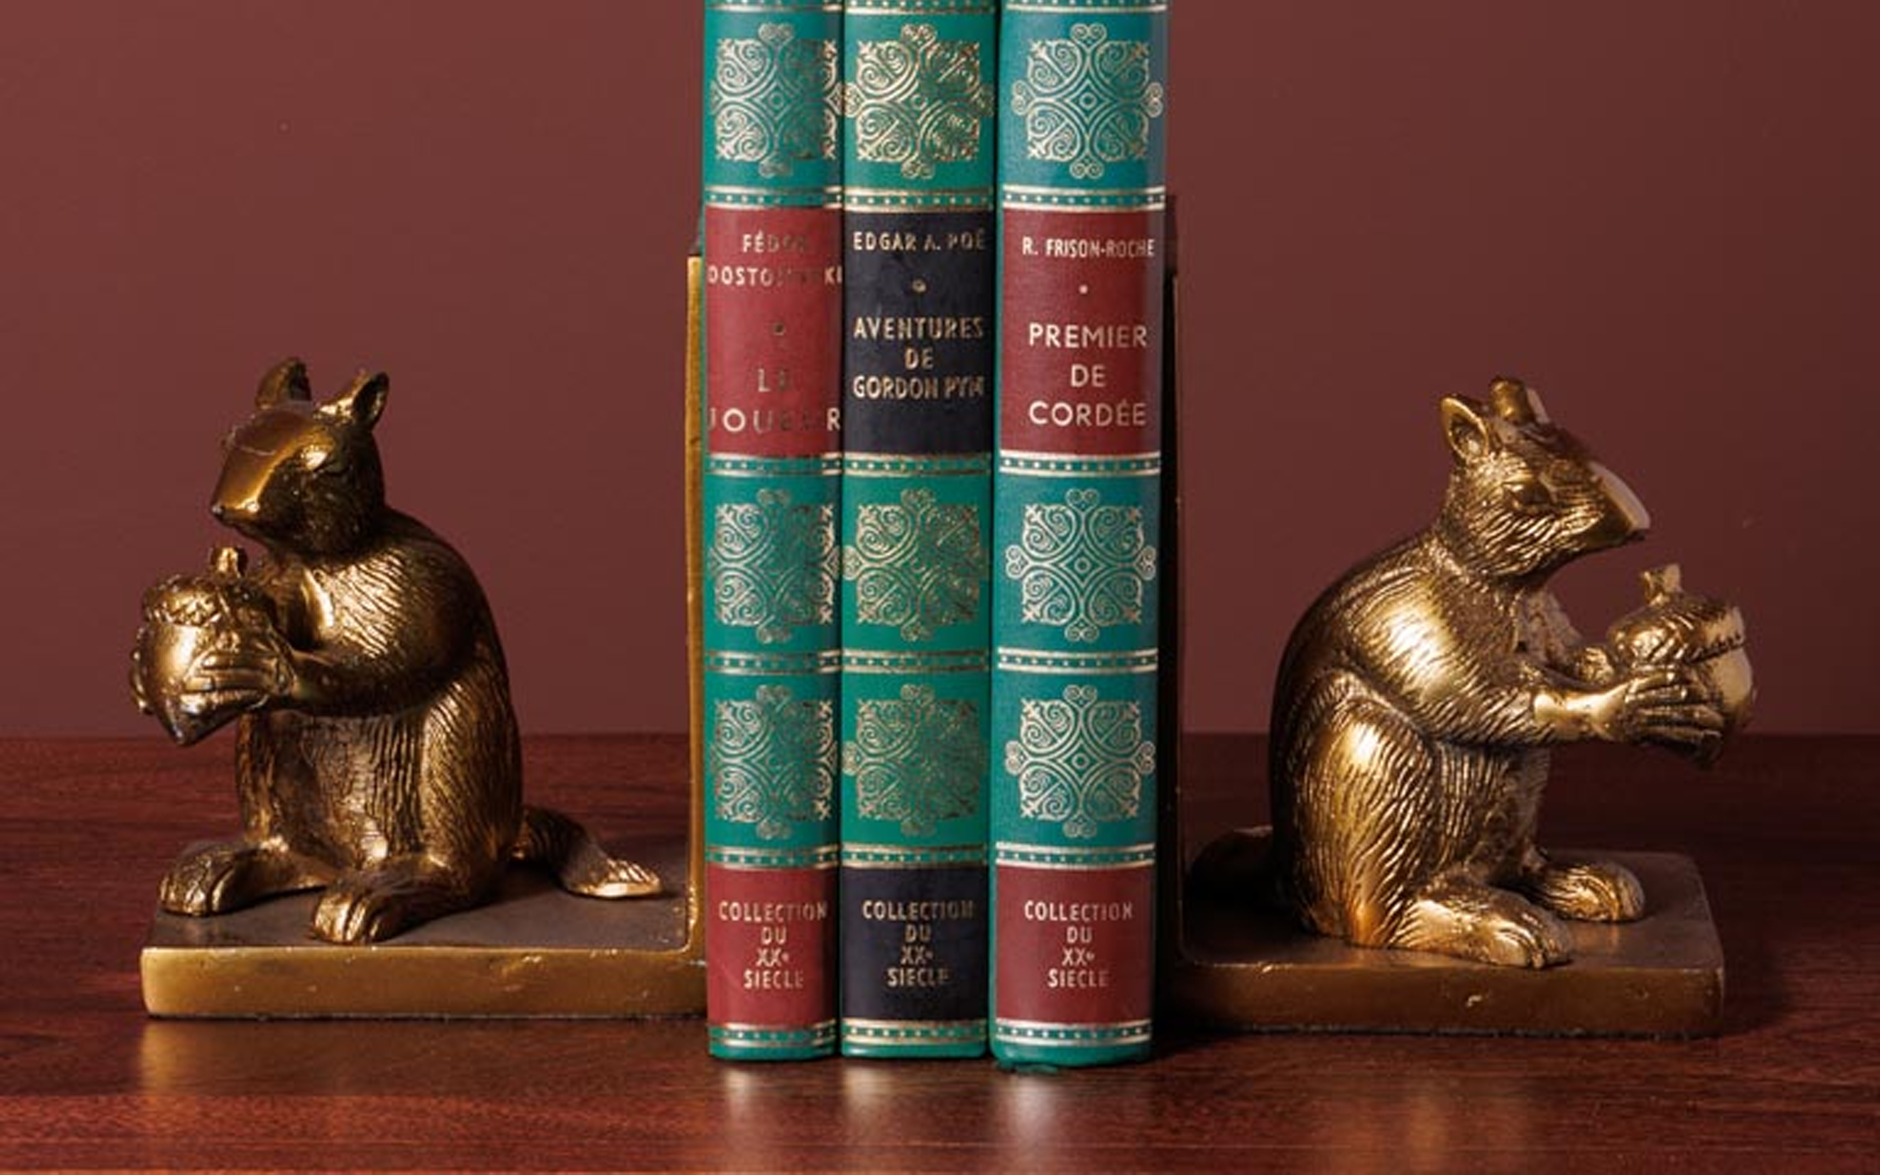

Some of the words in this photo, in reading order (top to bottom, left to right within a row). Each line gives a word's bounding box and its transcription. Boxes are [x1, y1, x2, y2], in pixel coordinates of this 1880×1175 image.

[853, 231, 917, 251] EDGAR
[924, 234, 941, 251] A.
[1022, 236, 1038, 255] R.
[1046, 238, 1156, 258] FRISON-ROCHE
[853, 316, 984, 340] AVENTURES
[1029, 322, 1147, 349] PREMIER
[905, 348, 934, 369] DE
[1071, 364, 1106, 387] DE
[853, 376, 939, 399] GORDON
[944, 377, 985, 399] PYM
[1029, 399, 1147, 427] CORDÉE
[719, 901, 827, 922] COLLECTION
[862, 900, 973, 921] COLLECTION
[1024, 900, 1133, 922] COLLECTION
[762, 926, 787, 945] DU
[905, 924, 931, 943] DU
[1066, 926, 1093, 944] DU
